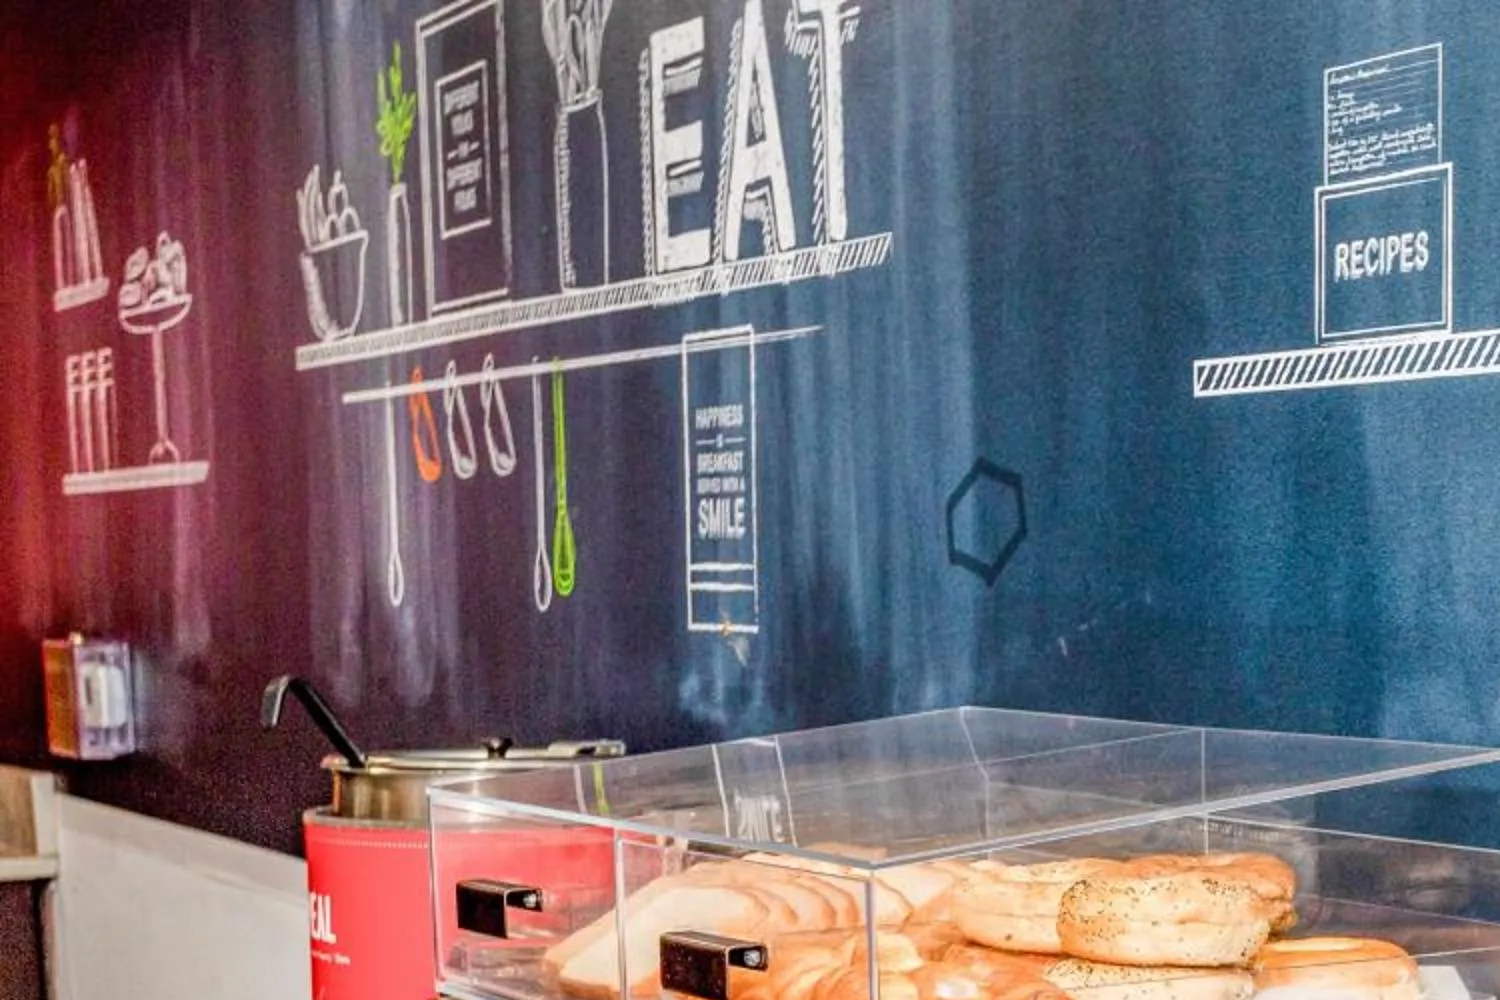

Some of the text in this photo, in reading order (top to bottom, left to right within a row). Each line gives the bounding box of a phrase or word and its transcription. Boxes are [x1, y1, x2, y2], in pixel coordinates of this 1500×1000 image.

[647, 0, 862, 274] EAT
[1334, 231, 1430, 282] RECIPES
[695, 404, 744, 430] HAPPINESS
[697, 450, 745, 474] BREAKFAST
[698, 497, 747, 540] SMILE
